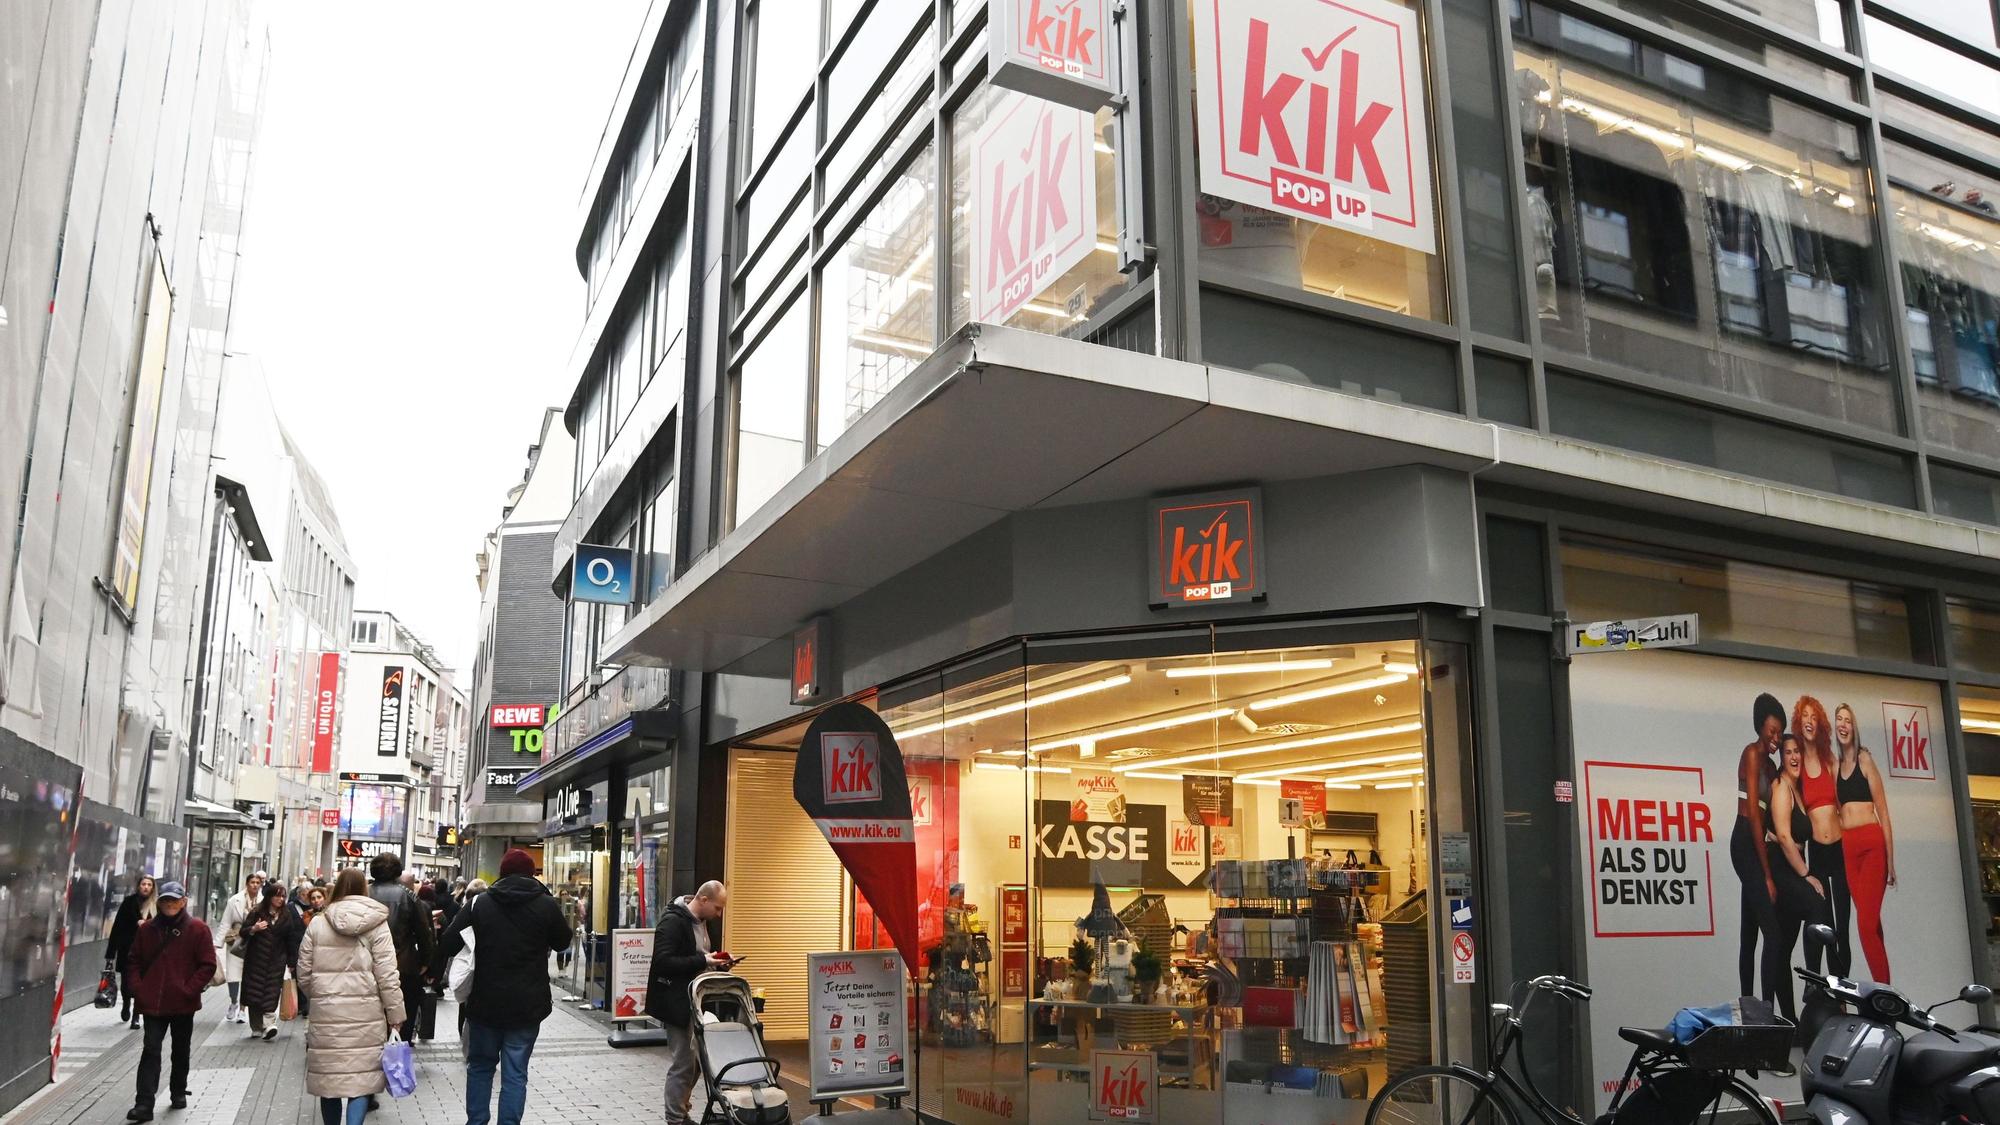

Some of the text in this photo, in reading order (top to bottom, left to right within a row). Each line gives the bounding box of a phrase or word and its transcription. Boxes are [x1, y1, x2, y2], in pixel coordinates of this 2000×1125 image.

[1026, 0, 1096, 65] kik
[1041, 55, 1082, 73] POP UP
[1239, 18, 1394, 195] kik
[987, 100, 1073, 294] kik
[1276, 176, 1367, 218] POP UP
[1003, 252, 1053, 308] POP UP
[1169, 510, 1245, 586] kik
[1186, 585, 1229, 598] POP UP
[318, 690, 333, 735] UNIQLO
[379, 697, 400, 752] SATURN
[493, 707, 541, 724] REWE
[510, 729, 544, 753] TO
[1891, 710, 1929, 771] kik
[487, 772, 517, 785] Fast.
[831, 738, 874, 794] kik
[564, 783, 581, 818] Live
[829, 824, 902, 838] www.kik.eu
[1596, 797, 1714, 843] MEHR
[361, 842, 402, 858] SATURN
[1033, 823, 1149, 860] KASSE
[1174, 824, 1197, 852] kik
[1600, 847, 1687, 874] ALS DU
[1601, 878, 1698, 906] DENKST
[823, 980, 874, 994] Jetzt Deine
[837, 990, 897, 1000] Vorteile sichern:
[1101, 1060, 1148, 1107] kik
[956, 1086, 1014, 1119] www.kik.de
[1110, 1108, 1126, 1116] POP
